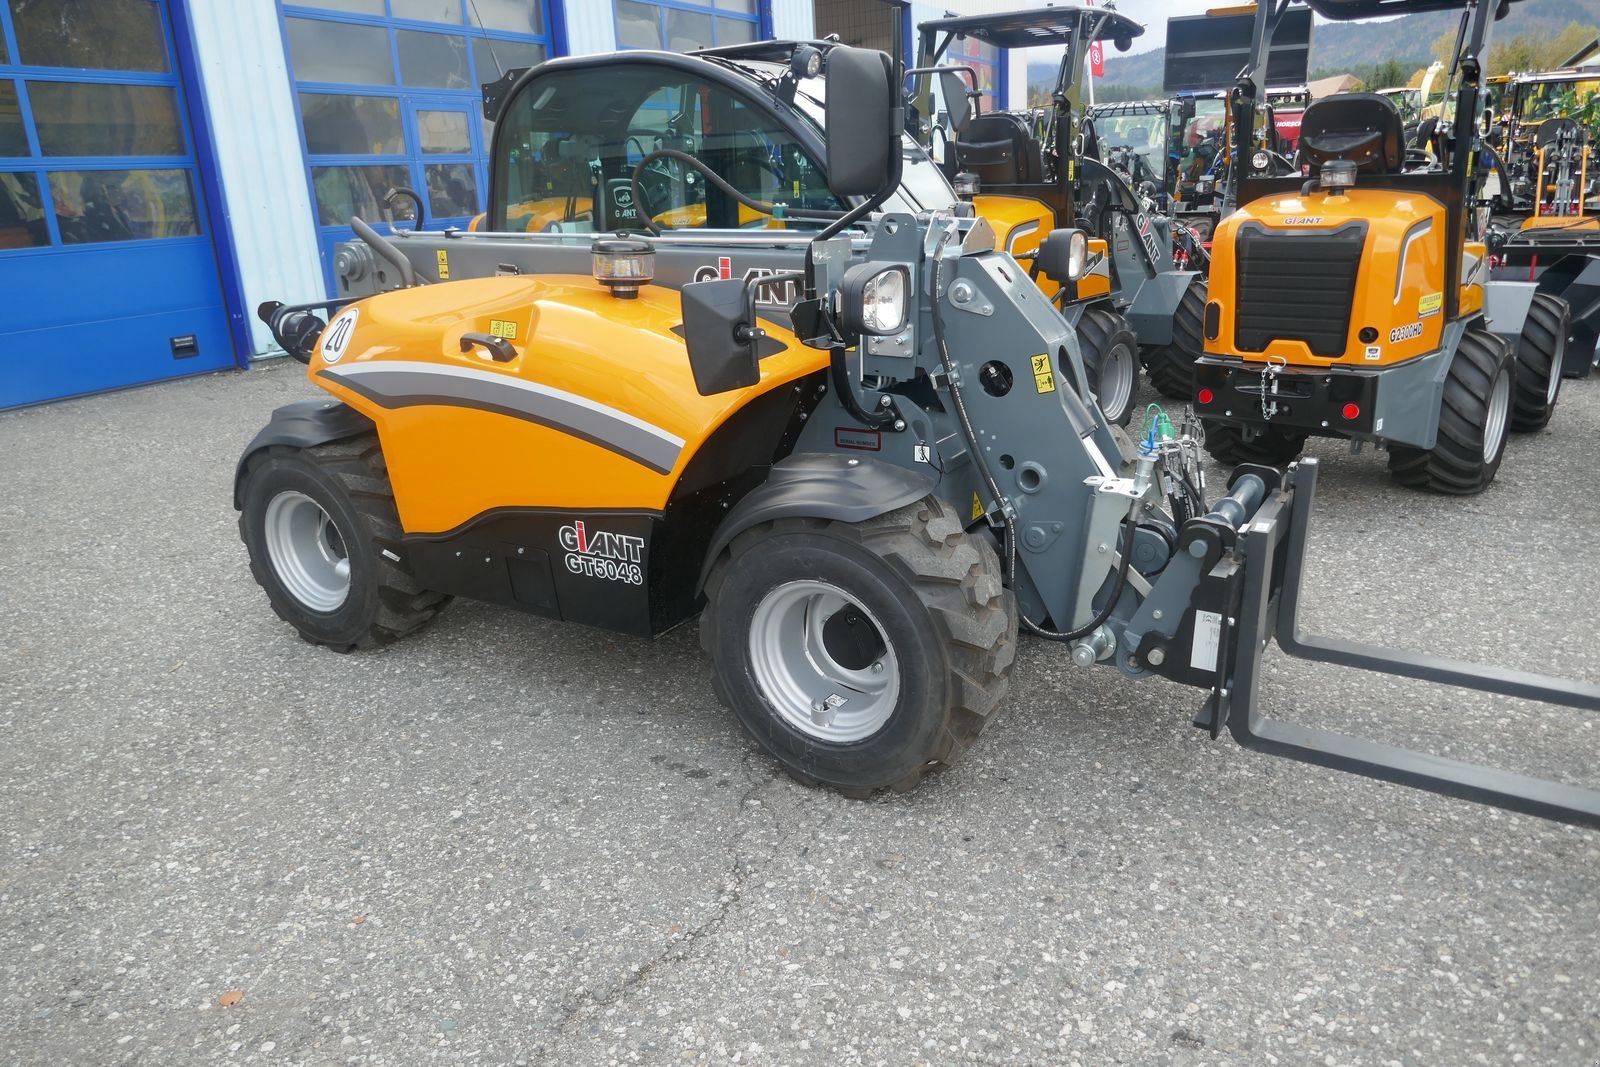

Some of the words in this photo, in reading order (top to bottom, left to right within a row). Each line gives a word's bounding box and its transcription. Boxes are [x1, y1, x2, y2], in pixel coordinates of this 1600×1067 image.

[614, 209, 637, 218] GANT
[325, 317, 353, 353] 20
[1389, 321, 1424, 344] G2300HD
[564, 553, 643, 586] GT5048
